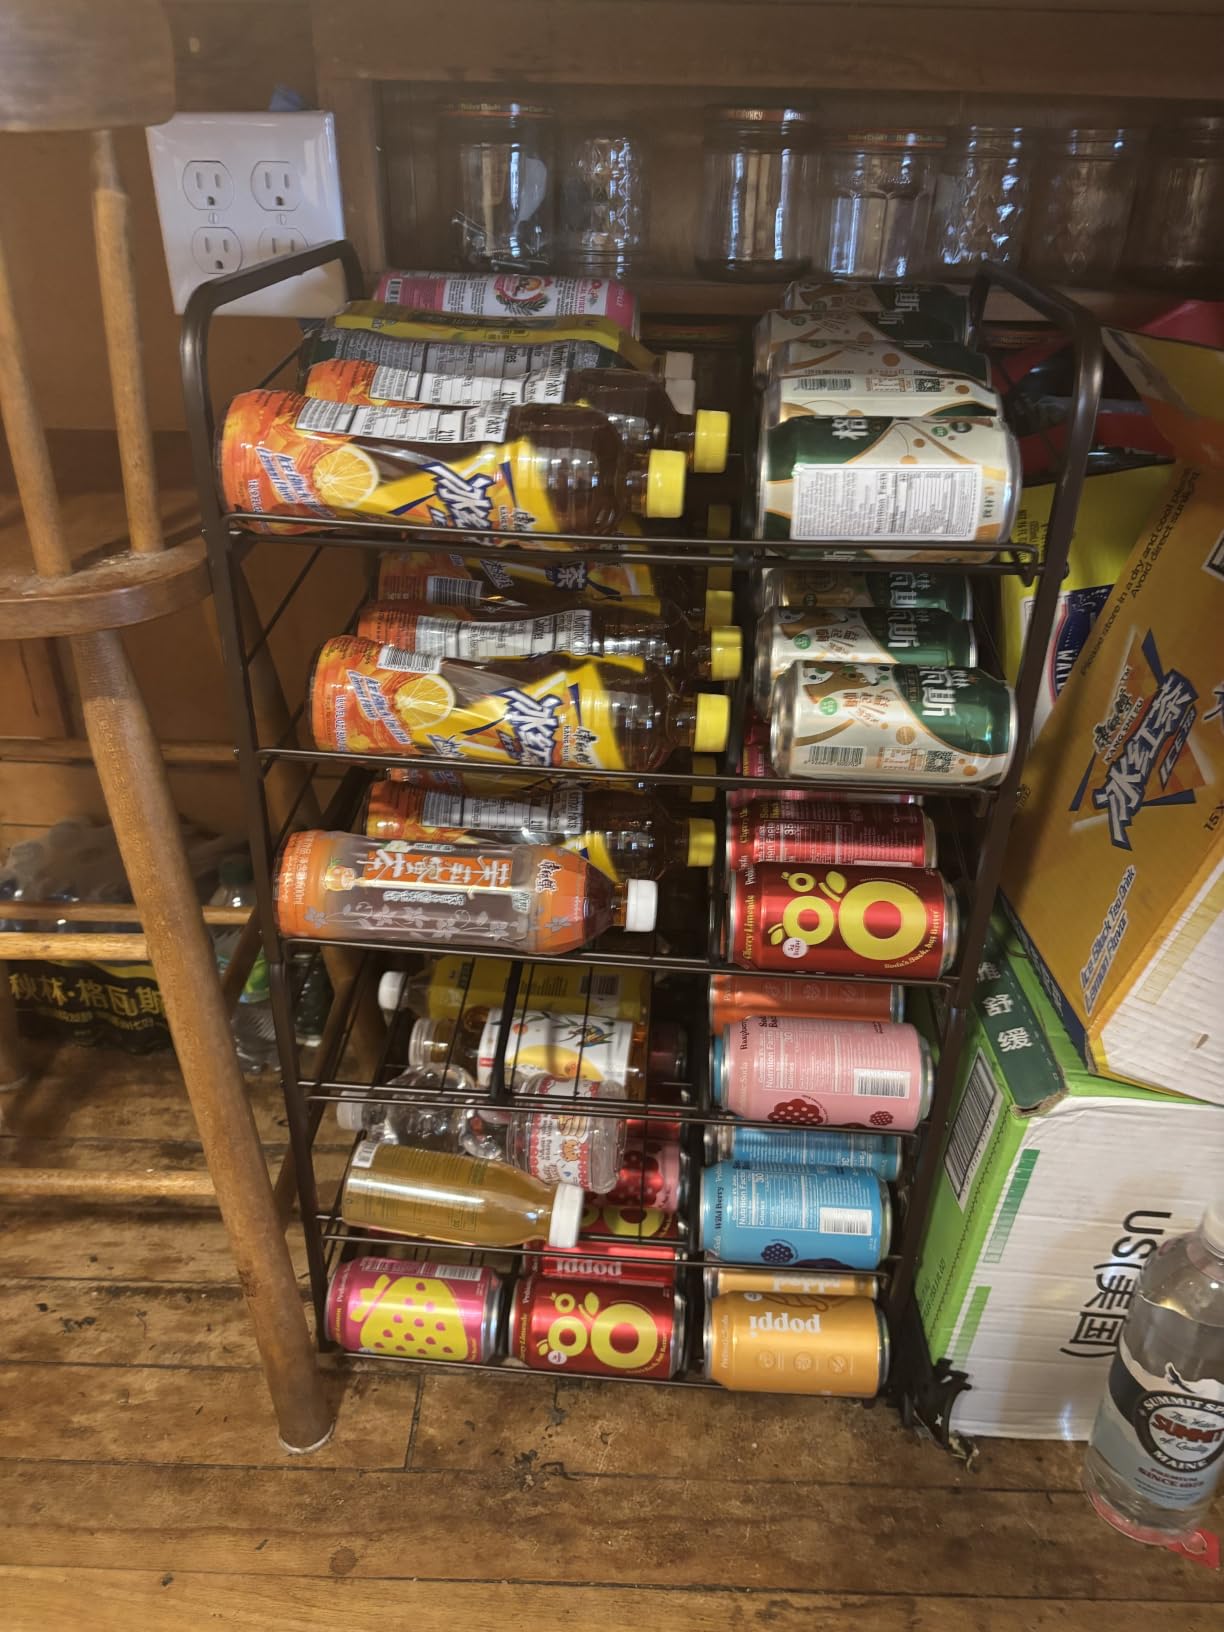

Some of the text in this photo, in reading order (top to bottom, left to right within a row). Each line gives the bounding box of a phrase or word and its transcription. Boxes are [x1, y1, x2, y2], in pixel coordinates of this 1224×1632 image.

[1102, 604, 1121, 637] store
[1118, 591, 1128, 604] in
[1131, 559, 1145, 582] dry
[1143, 532, 1159, 558] and
[1157, 502, 1173, 534] cool
[1131, 563, 1153, 598] Avoid
[1150, 524, 1173, 562] direct
[1105, 735, 1124, 761] KANG
[1122, 714, 1135, 737] SHI
[1094, 673, 1193, 845] 冰红茶
[1161, 738, 1184, 786] ICE
[747, 894, 756, 933] Limeade
[1081, 866, 1135, 988] Ice Black Tea Drink
[1085, 913, 1128, 1014] Lemon Flavor
[765, 1050, 775, 1088] Nutrition
[715, 1187, 724, 1208] Berry
[738, 1191, 748, 1225] Nutrition
[714, 1208, 723, 1229] Wild
[749, 1312, 821, 1338] poppi
[1144, 1396, 1203, 1410] SUMMIT
[1138, 1467, 1178, 1487] SINCE
[1152, 1450, 1209, 1470] MAINE
